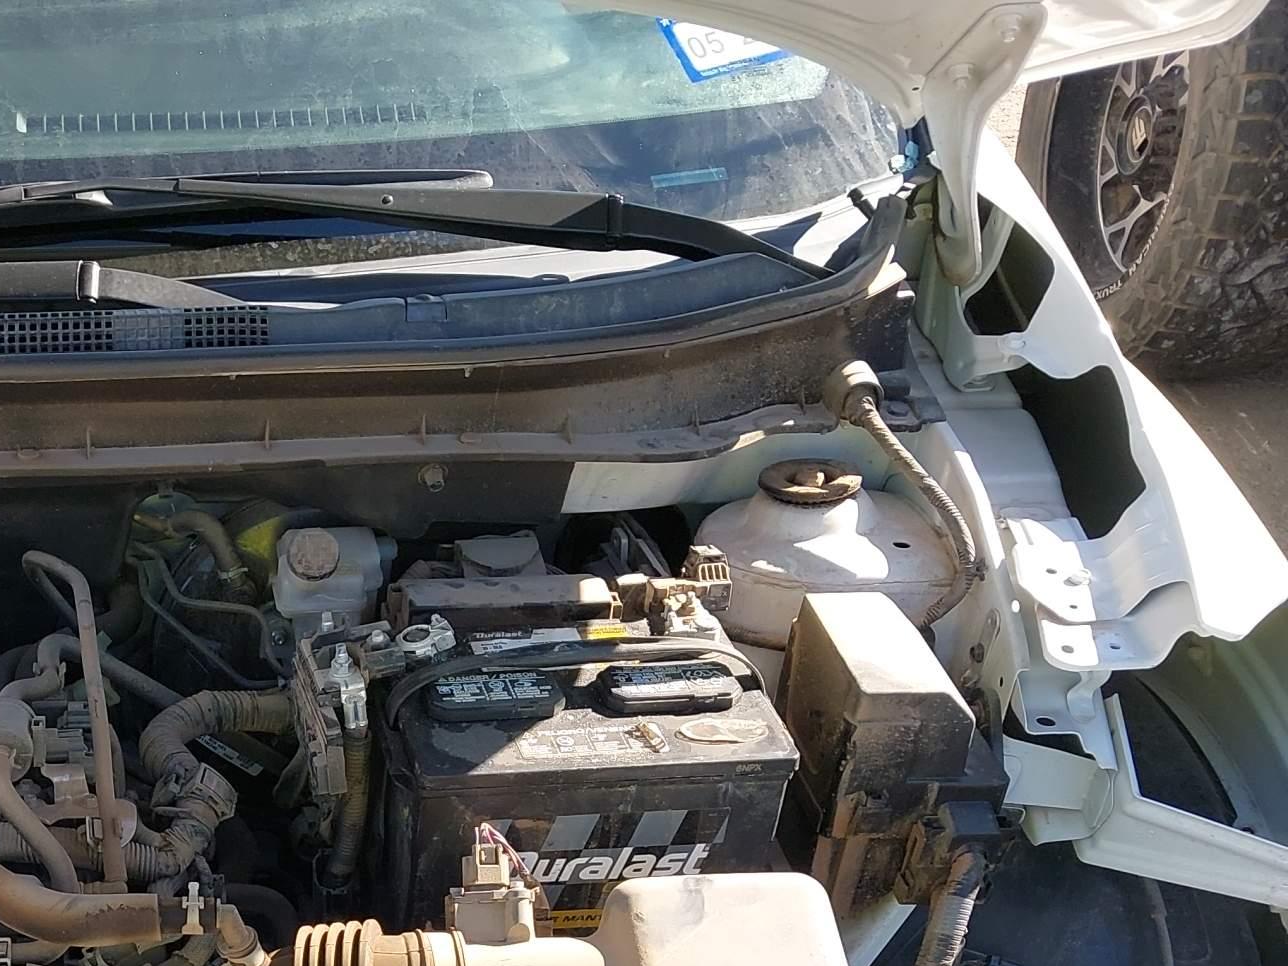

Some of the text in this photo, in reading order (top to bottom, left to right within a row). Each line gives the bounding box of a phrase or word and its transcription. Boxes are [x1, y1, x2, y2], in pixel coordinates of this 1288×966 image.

[687, 31, 725, 58] 05
[473, 631, 524, 639] Duralast
[448, 674, 489, 682] DANGER
